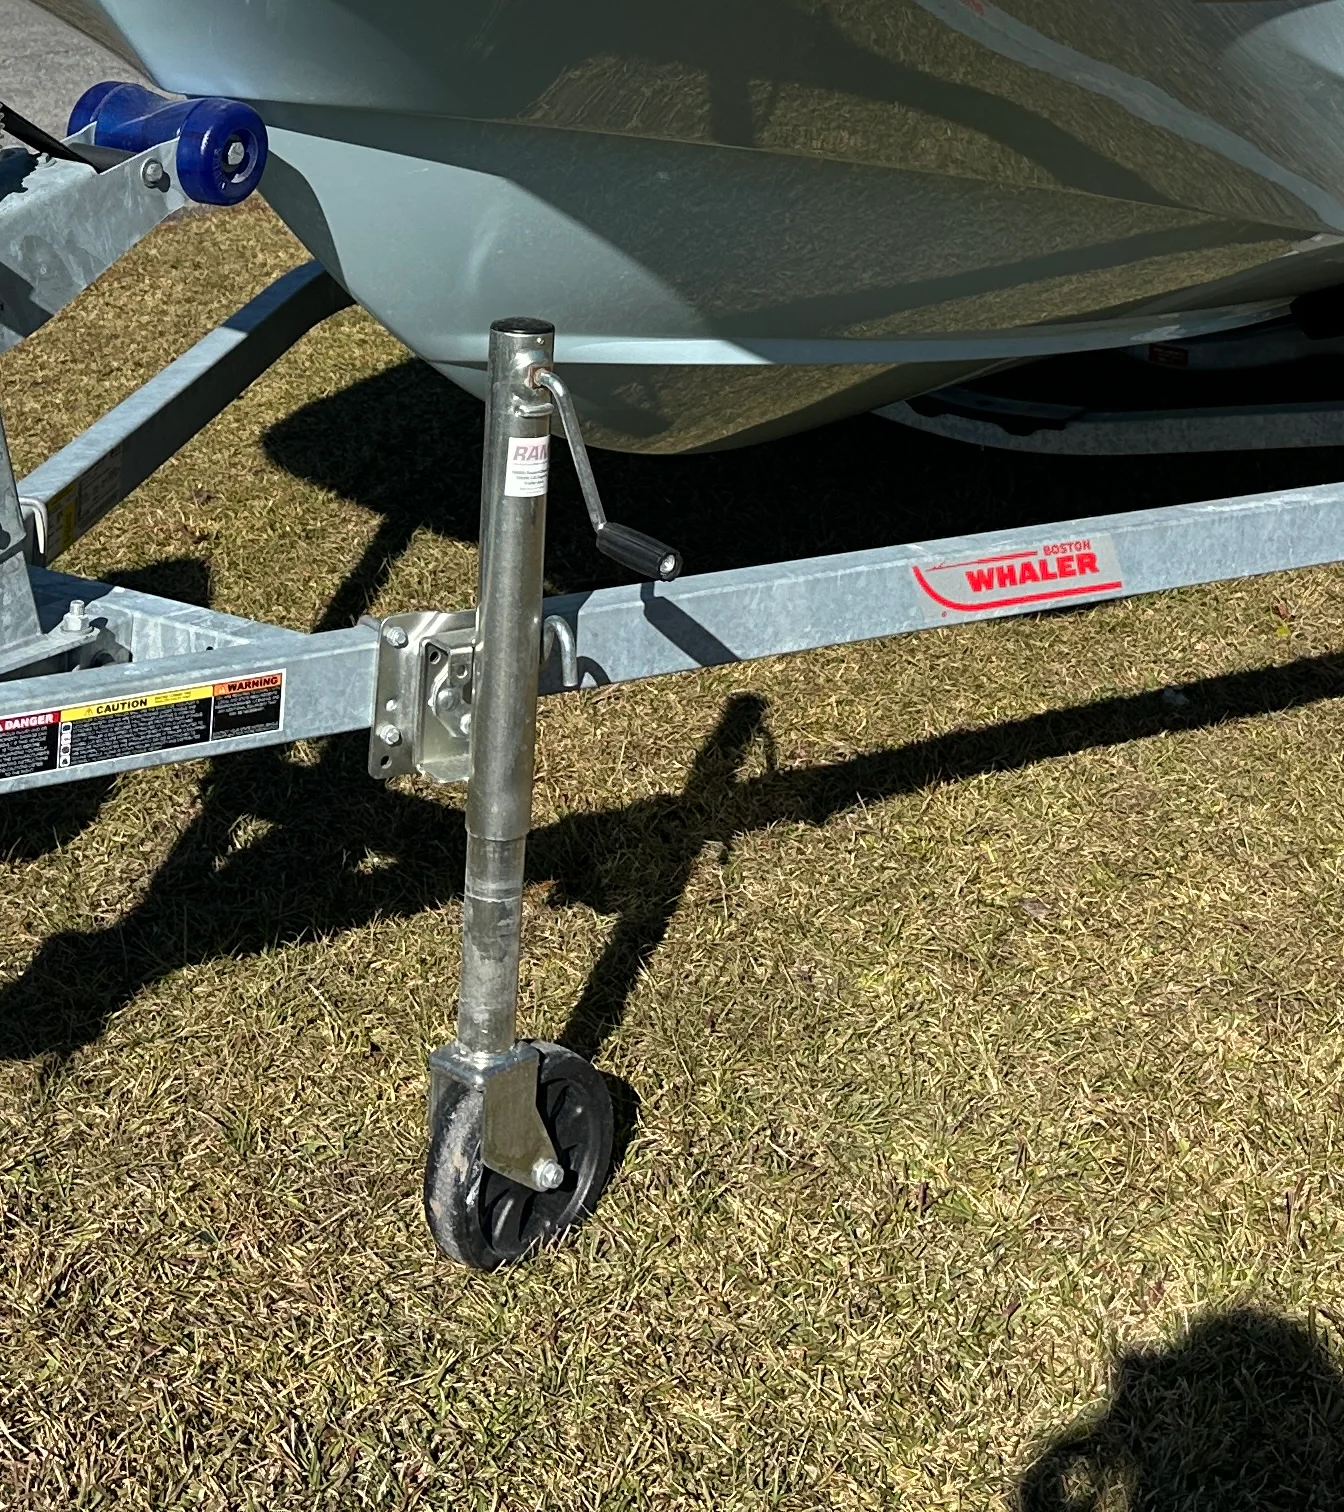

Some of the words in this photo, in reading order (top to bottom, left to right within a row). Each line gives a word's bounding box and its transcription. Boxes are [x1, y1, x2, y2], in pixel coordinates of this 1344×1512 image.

[1043, 539, 1092, 556] BOSTON
[965, 552, 1100, 593] WHALER
[227, 676, 279, 692] WARNING
[96, 698, 148, 715] CAUTION
[4, 713, 54, 730] DANGER
